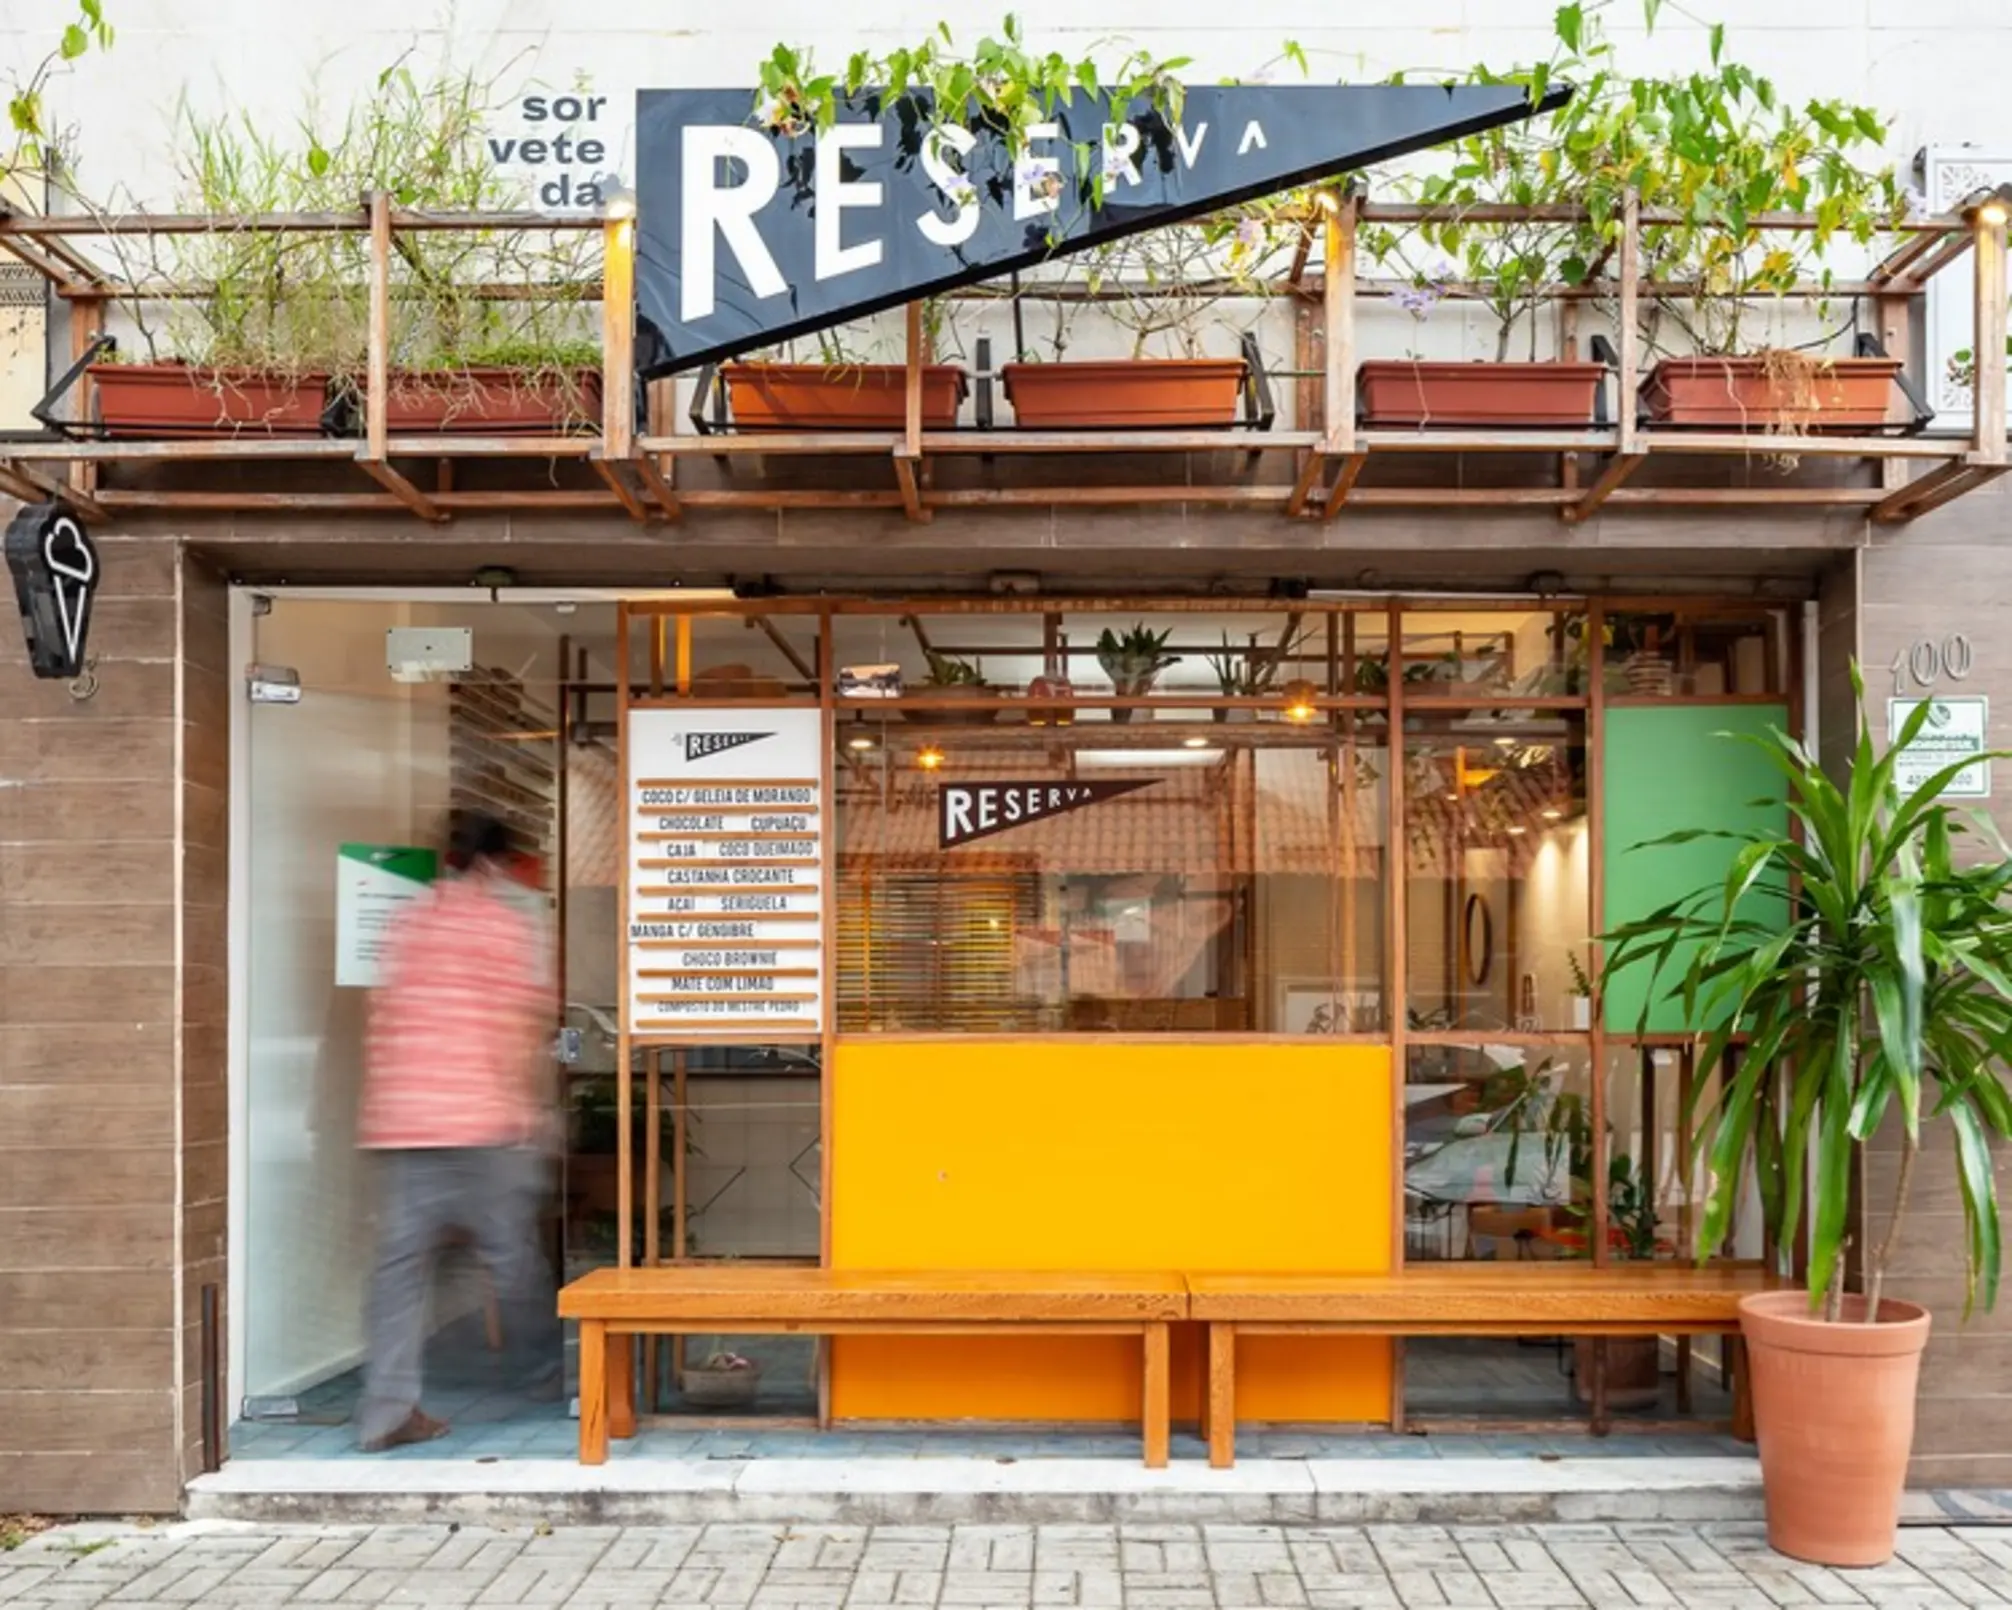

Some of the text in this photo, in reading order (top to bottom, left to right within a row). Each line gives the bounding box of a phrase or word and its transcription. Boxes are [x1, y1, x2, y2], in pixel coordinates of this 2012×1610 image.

[522, 96, 607, 122] sor
[488, 132, 605, 164] vete
[541, 173, 606, 207] da
[681, 121, 1268, 324] RESERVA
[1889, 632, 1974, 696] 100
[642, 787, 811, 804] COCO C/ GELEIA DE MORANGO
[946, 787, 1093, 839] RESERVA
[659, 815, 725, 831] CHOCOLATE
[718, 841, 813, 857] COCO QUEIMADO
[667, 868, 795, 884] CASTANHA CROCANTE
[720, 896, 788, 911] SERIGUELA
[630, 925, 674, 937] MANGA
[677, 924, 694, 937] C/
[682, 951, 778, 966] CHOCO BROWNIE
[671, 977, 703, 991] MATE
[705, 977, 734, 991] COM
